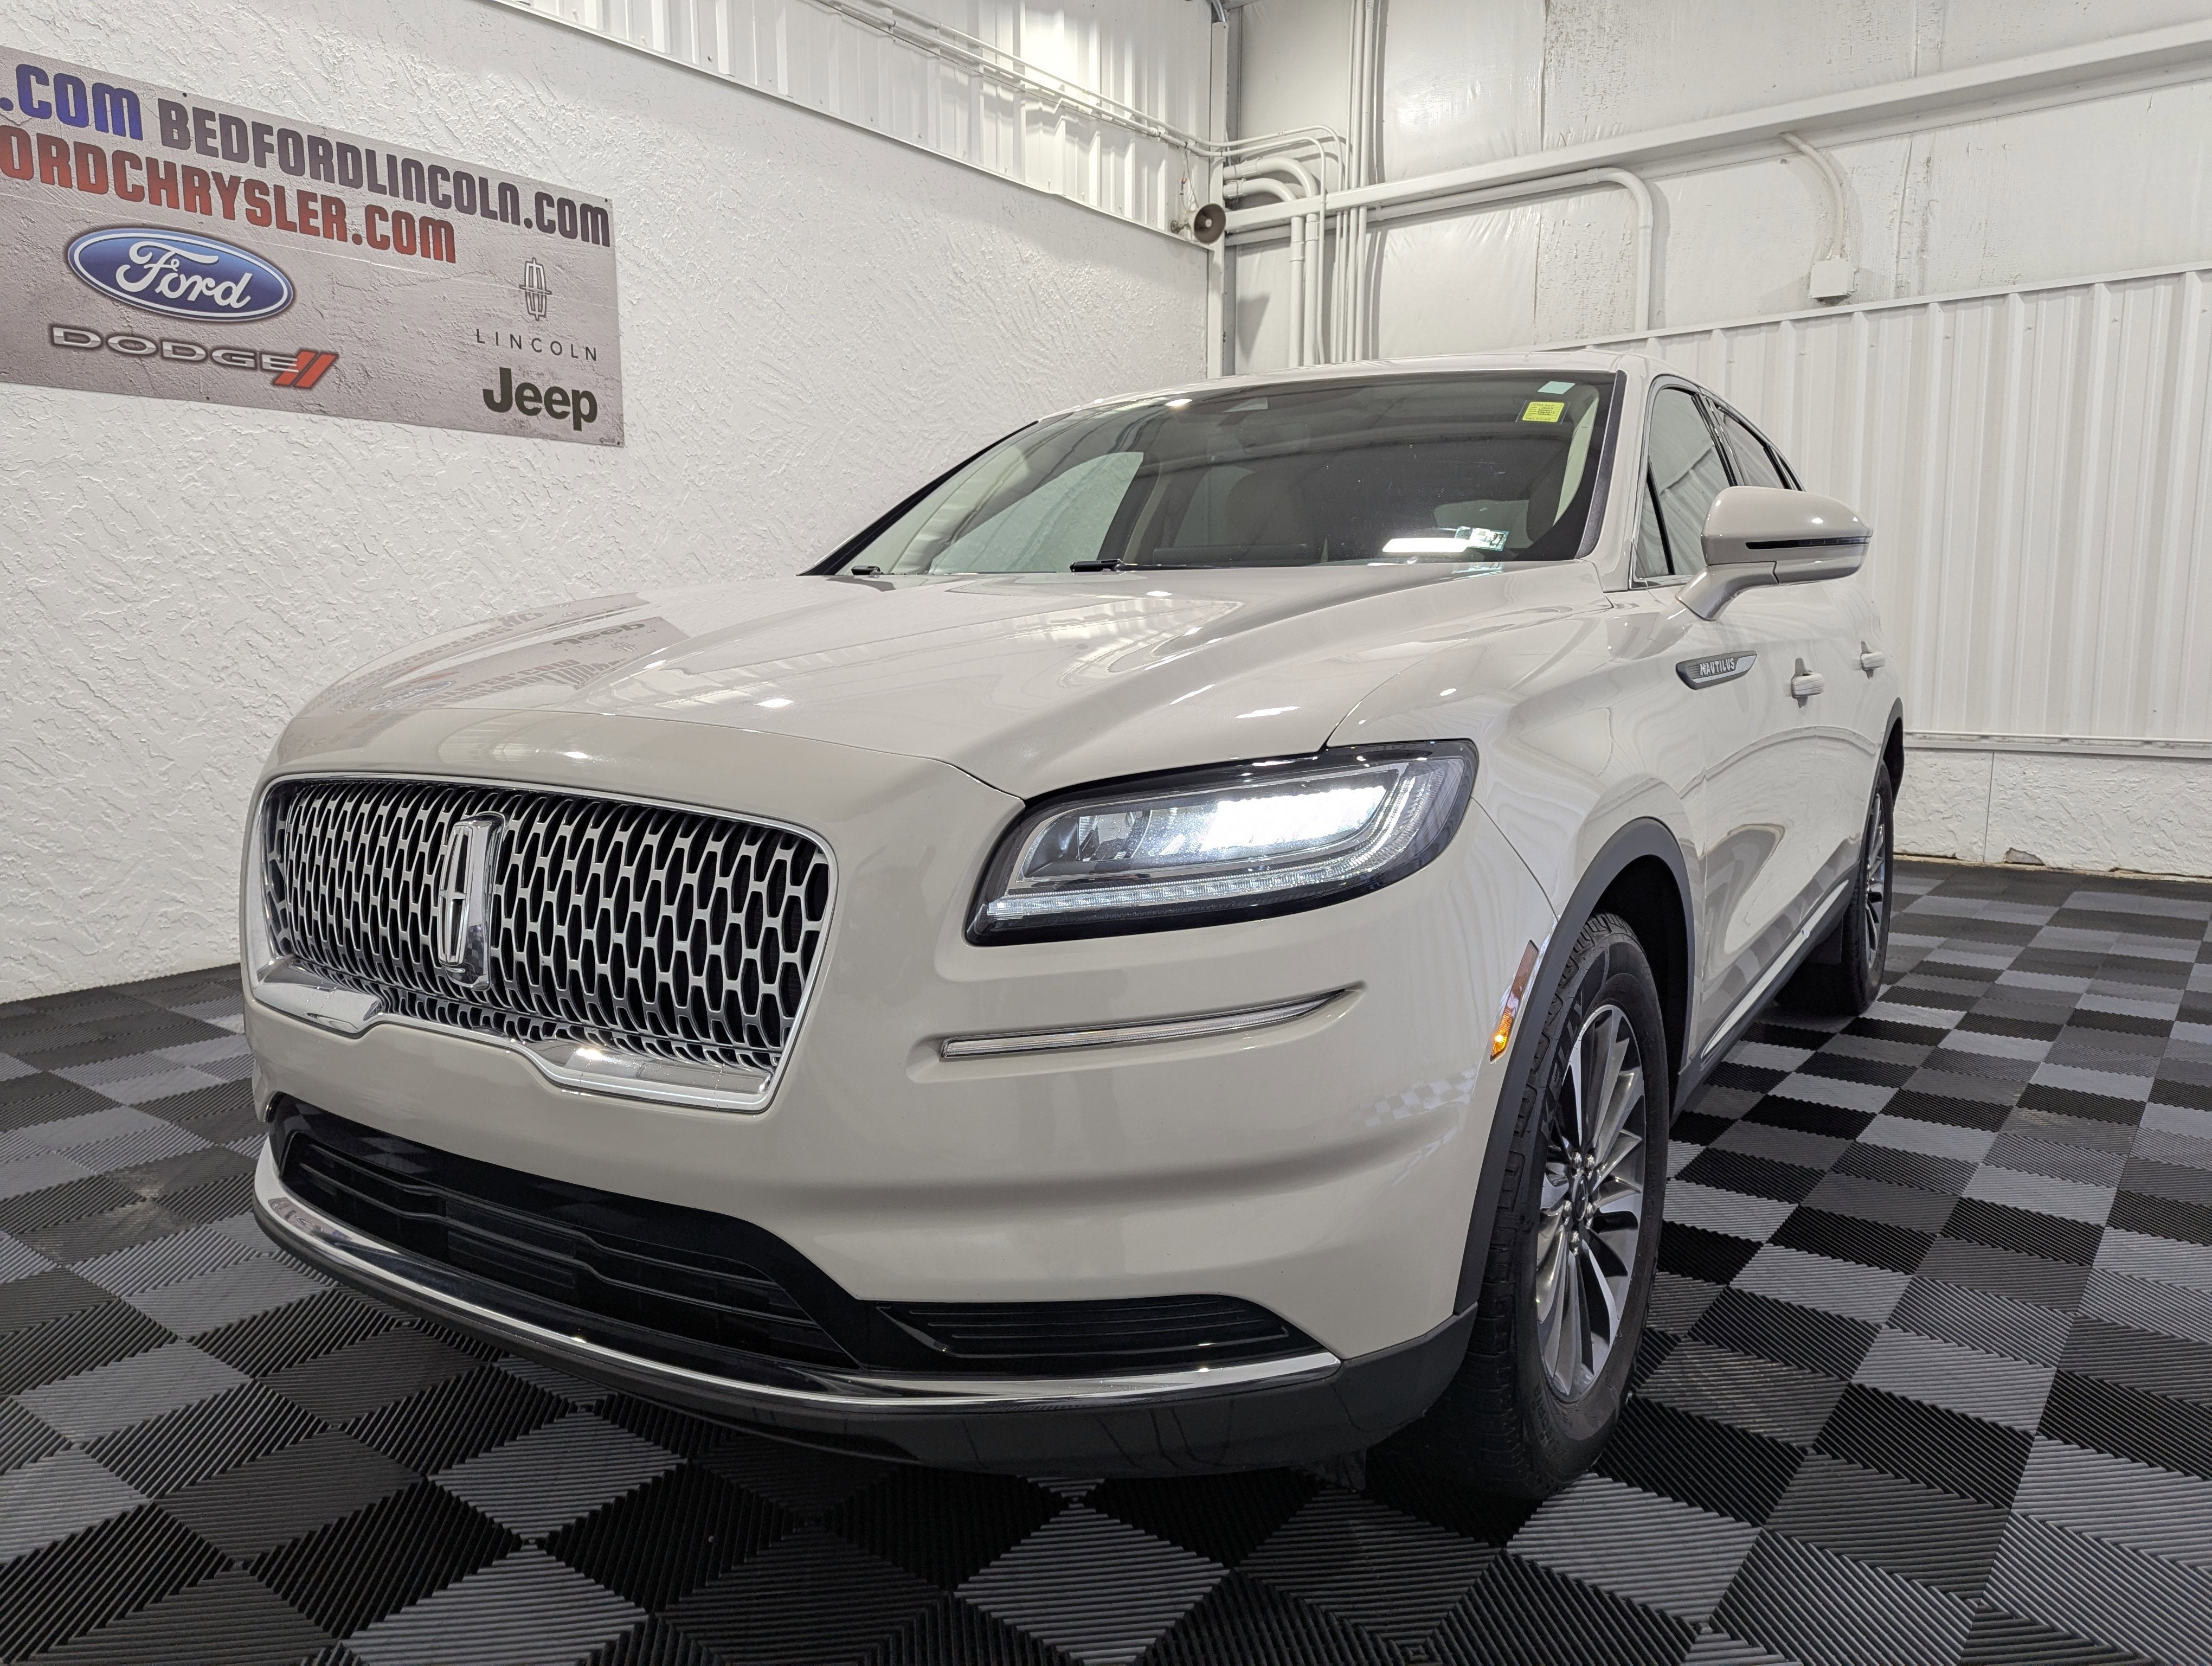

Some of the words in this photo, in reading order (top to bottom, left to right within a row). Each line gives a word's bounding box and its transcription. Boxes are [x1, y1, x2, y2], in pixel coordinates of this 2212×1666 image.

[157, 98, 610, 247] BEDFORDLINCOLN.COM
[115, 241, 253, 308] Ford
[53, 326, 299, 373] DODGE
[476, 328, 597, 361] LINCOLN
[482, 367, 598, 432] Jeep
[1699, 657, 1735, 676] NAUTILUS
[1541, 988, 1584, 1140] KELLY
